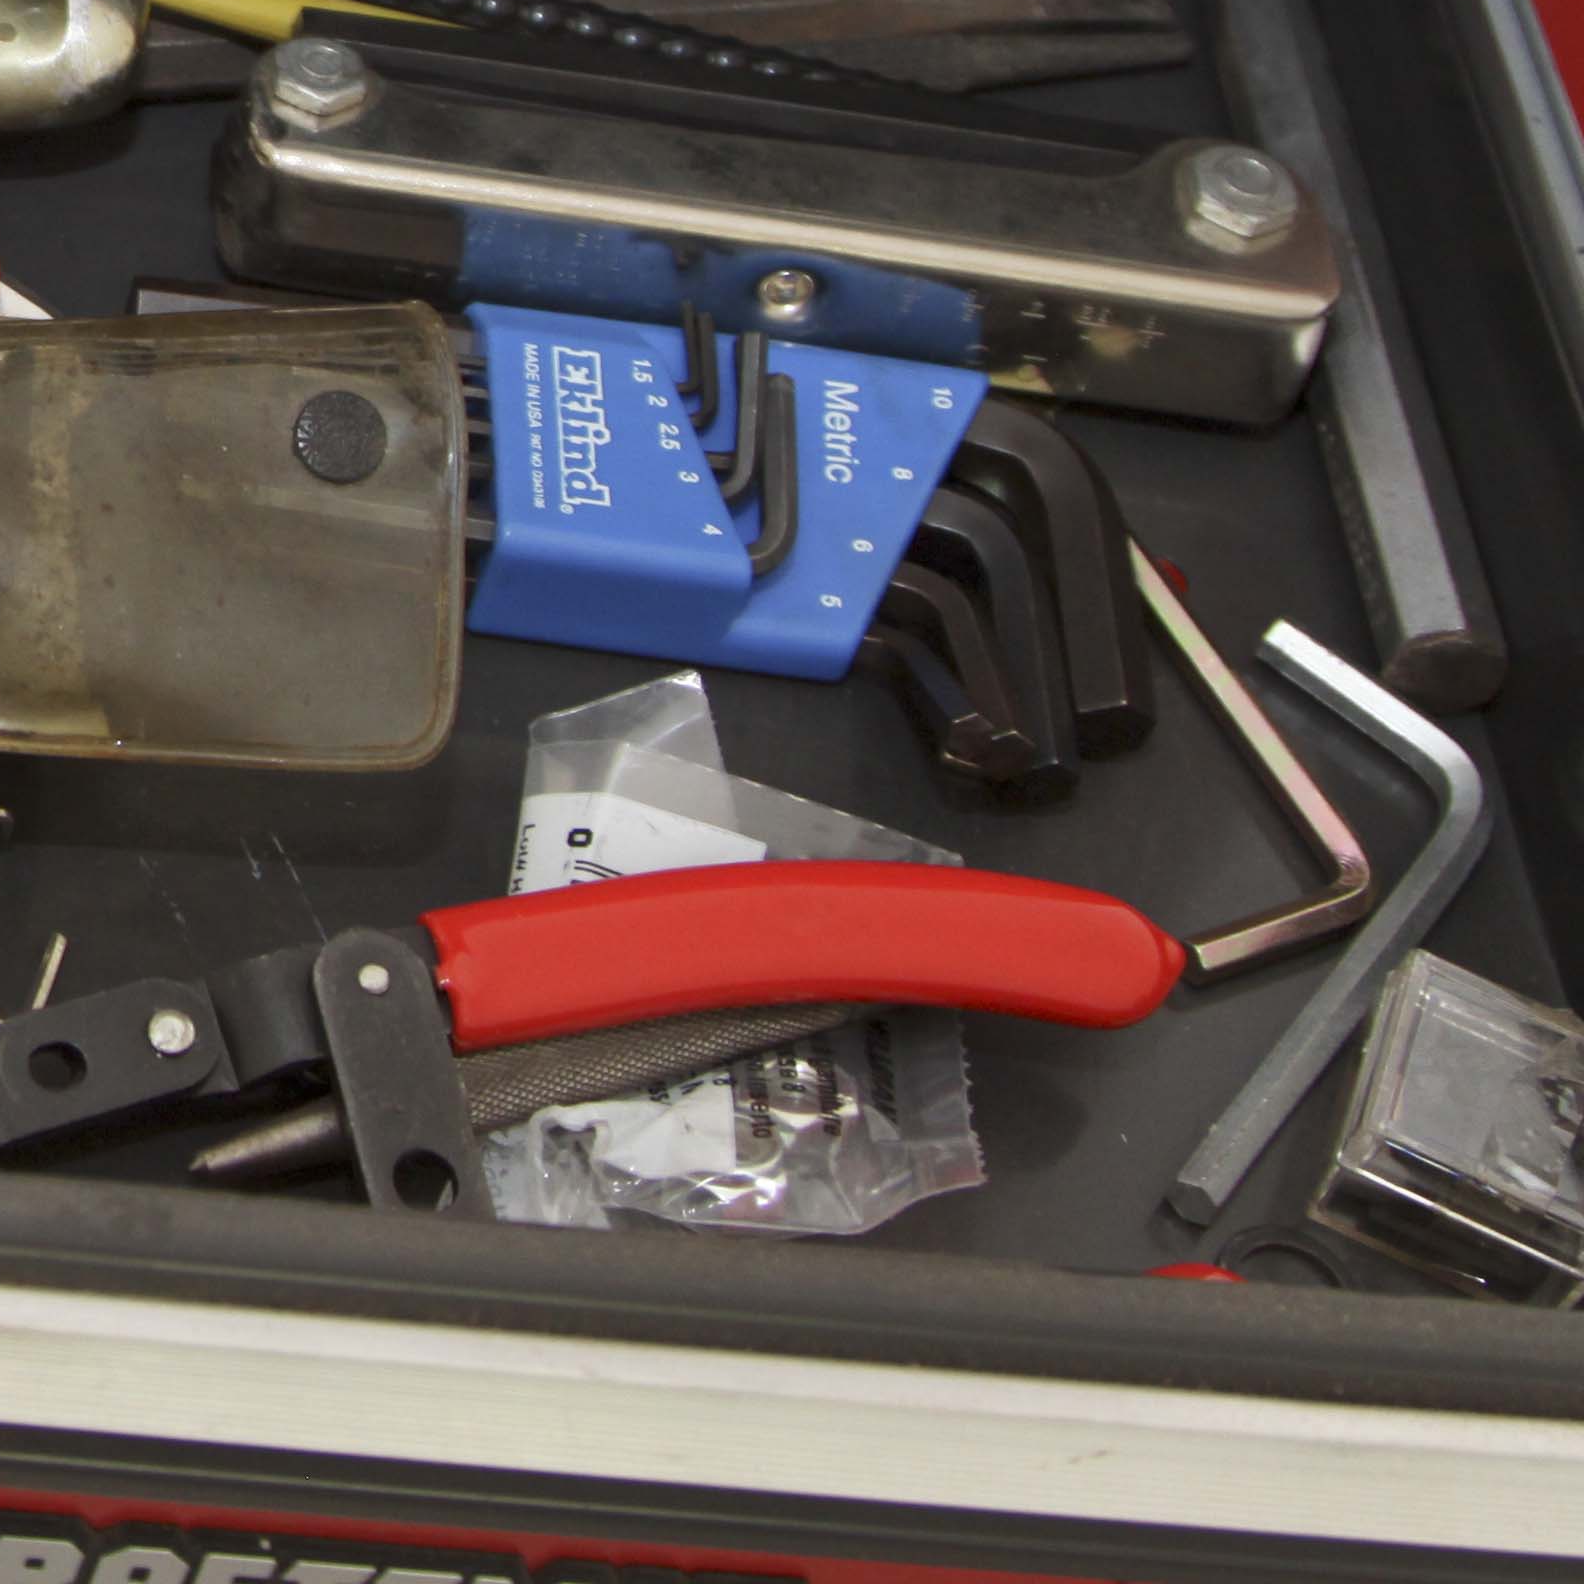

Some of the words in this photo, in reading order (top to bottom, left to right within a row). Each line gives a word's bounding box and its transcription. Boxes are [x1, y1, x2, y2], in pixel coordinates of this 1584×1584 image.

[523, 342, 541, 382] MADE
[631, 359, 654, 383] 1.5
[646, 393, 669, 408] 2
[932, 386, 953, 410] 10
[527, 400, 544, 429] USA
[552, 346, 611, 507] Eklind
[658, 422, 681, 451] 2.5
[823, 379, 860, 484] Metric
[677, 470, 700, 484] 3
[890, 466, 914, 481] 8
[701, 523, 724, 536] 4
[850, 538, 874, 553] 6
[819, 594, 843, 609] 5
